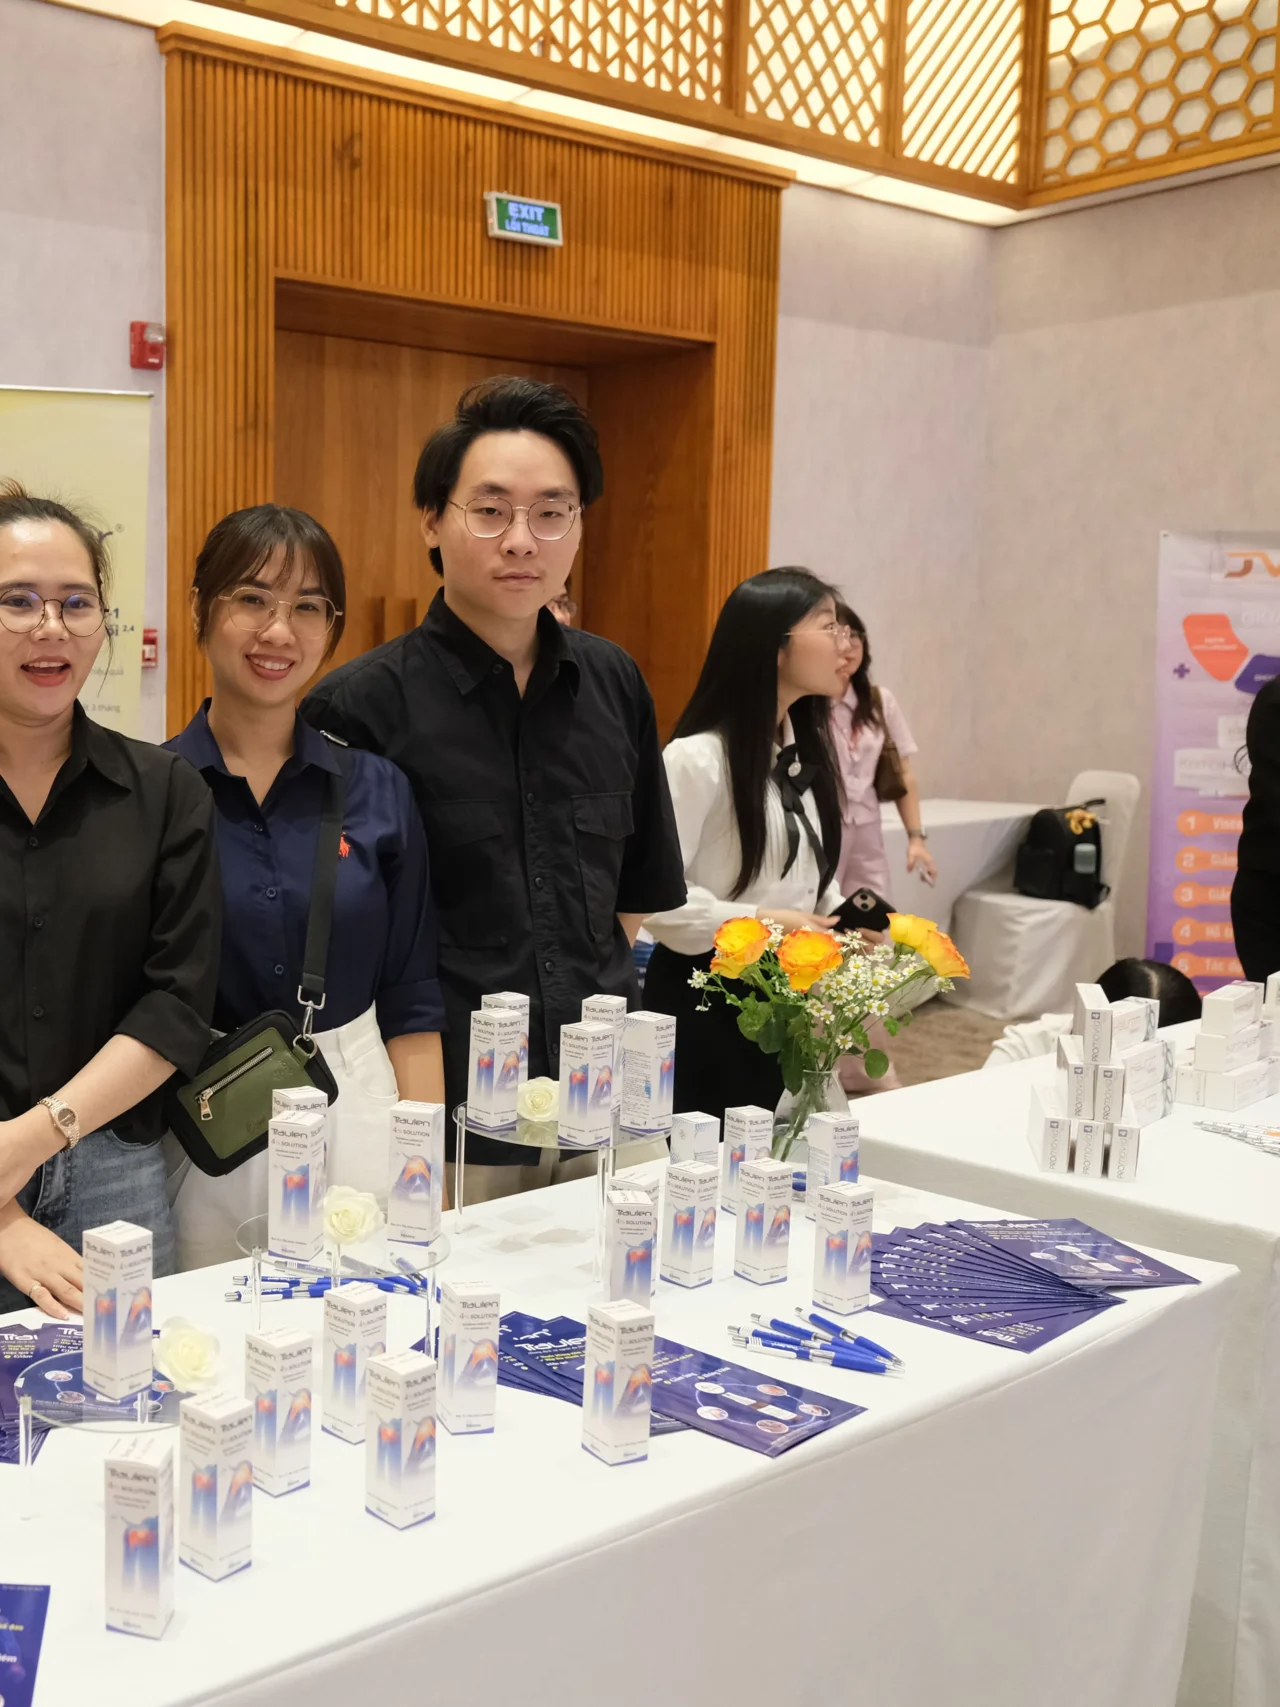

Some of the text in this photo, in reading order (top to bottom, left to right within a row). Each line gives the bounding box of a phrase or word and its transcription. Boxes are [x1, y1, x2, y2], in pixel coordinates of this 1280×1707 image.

[508, 202, 545, 222] EXIT
[1187, 816, 1196, 830] 1
[1182, 853, 1194, 867] 2
[1182, 888, 1193, 902] 3
[1180, 924, 1191, 938] 4
[584, 1006, 613, 1014] Traulen
[562, 1032, 588, 1042] Traulen
[294, 1102, 326, 1111] Traulen
[393, 1116, 430, 1127] Traulen
[271, 1128, 308, 1139] Traulen
[403, 1129, 430, 1137] SOLUTION
[281, 1141, 308, 1149] SOLUTION
[668, 1172, 695, 1184] Traulen
[740, 1169, 764, 1181] Traulen
[674, 1185, 694, 1193] SOLUTION
[819, 1194, 848, 1207] Traulen
[826, 1206, 847, 1216] SOLUTION
[326, 1300, 355, 1317] Traulen
[360, 1303, 386, 1316] Traulen
[460, 1301, 498, 1309] Traulen
[333, 1316, 355, 1327] SOLUTION
[247, 1341, 276, 1361] Traulen
[281, 1347, 312, 1361] Traulen
